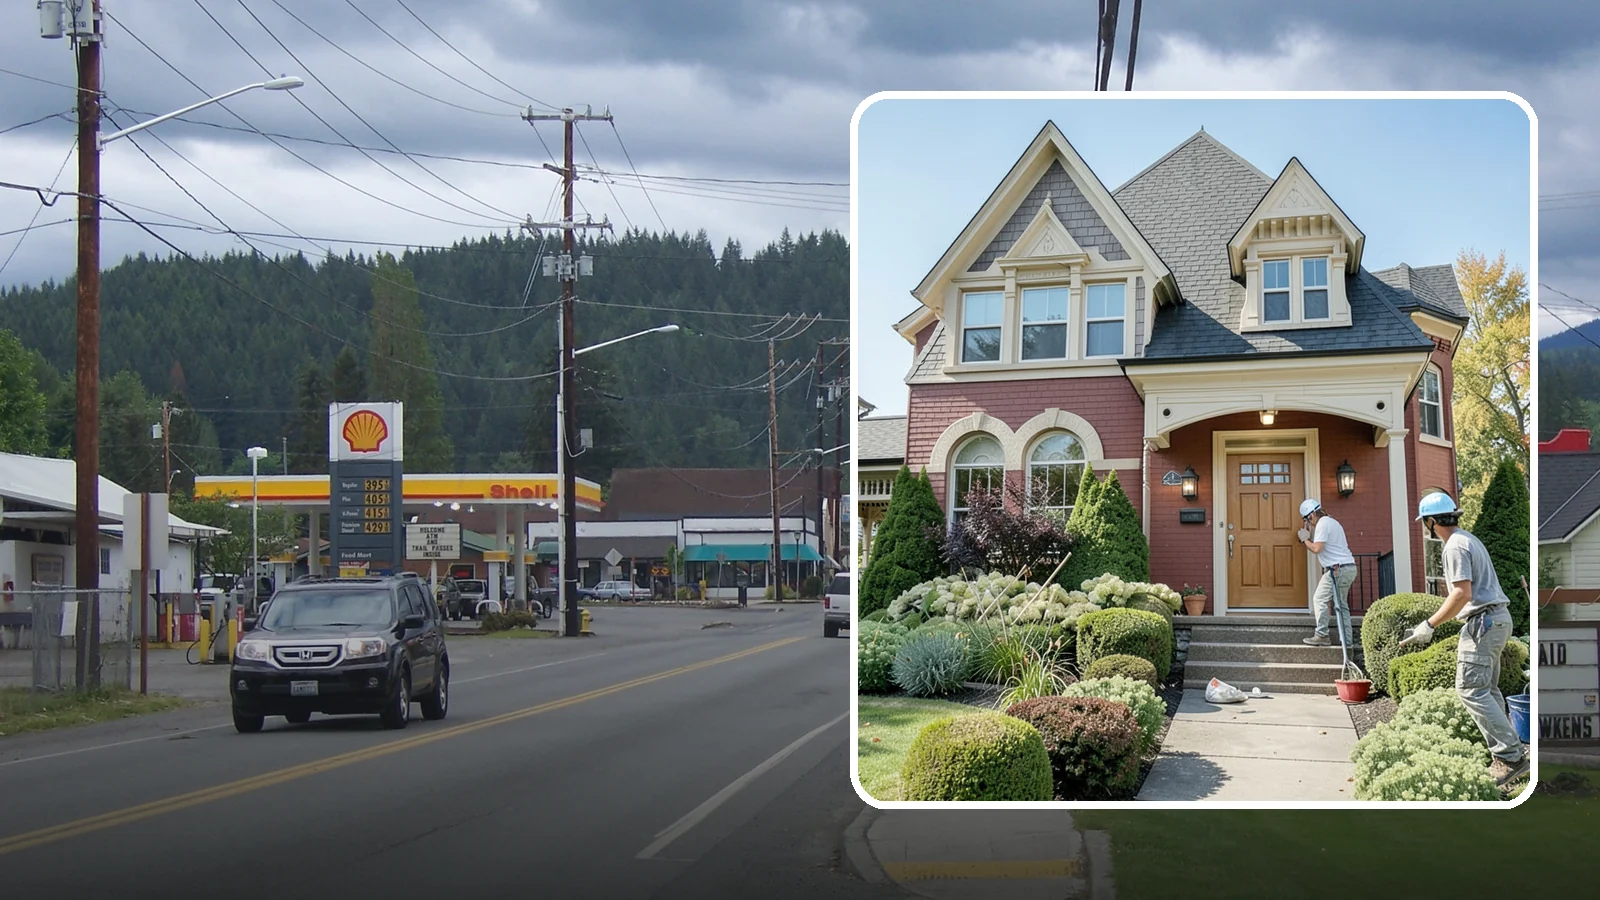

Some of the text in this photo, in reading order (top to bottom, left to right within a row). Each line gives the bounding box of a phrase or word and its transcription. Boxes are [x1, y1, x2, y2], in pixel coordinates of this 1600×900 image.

[366, 480, 383, 490] 395
[490, 484, 547, 499] Shell
[366, 494, 383, 504] 405
[366, 508, 383, 518] 415
[366, 522, 383, 532] 429
